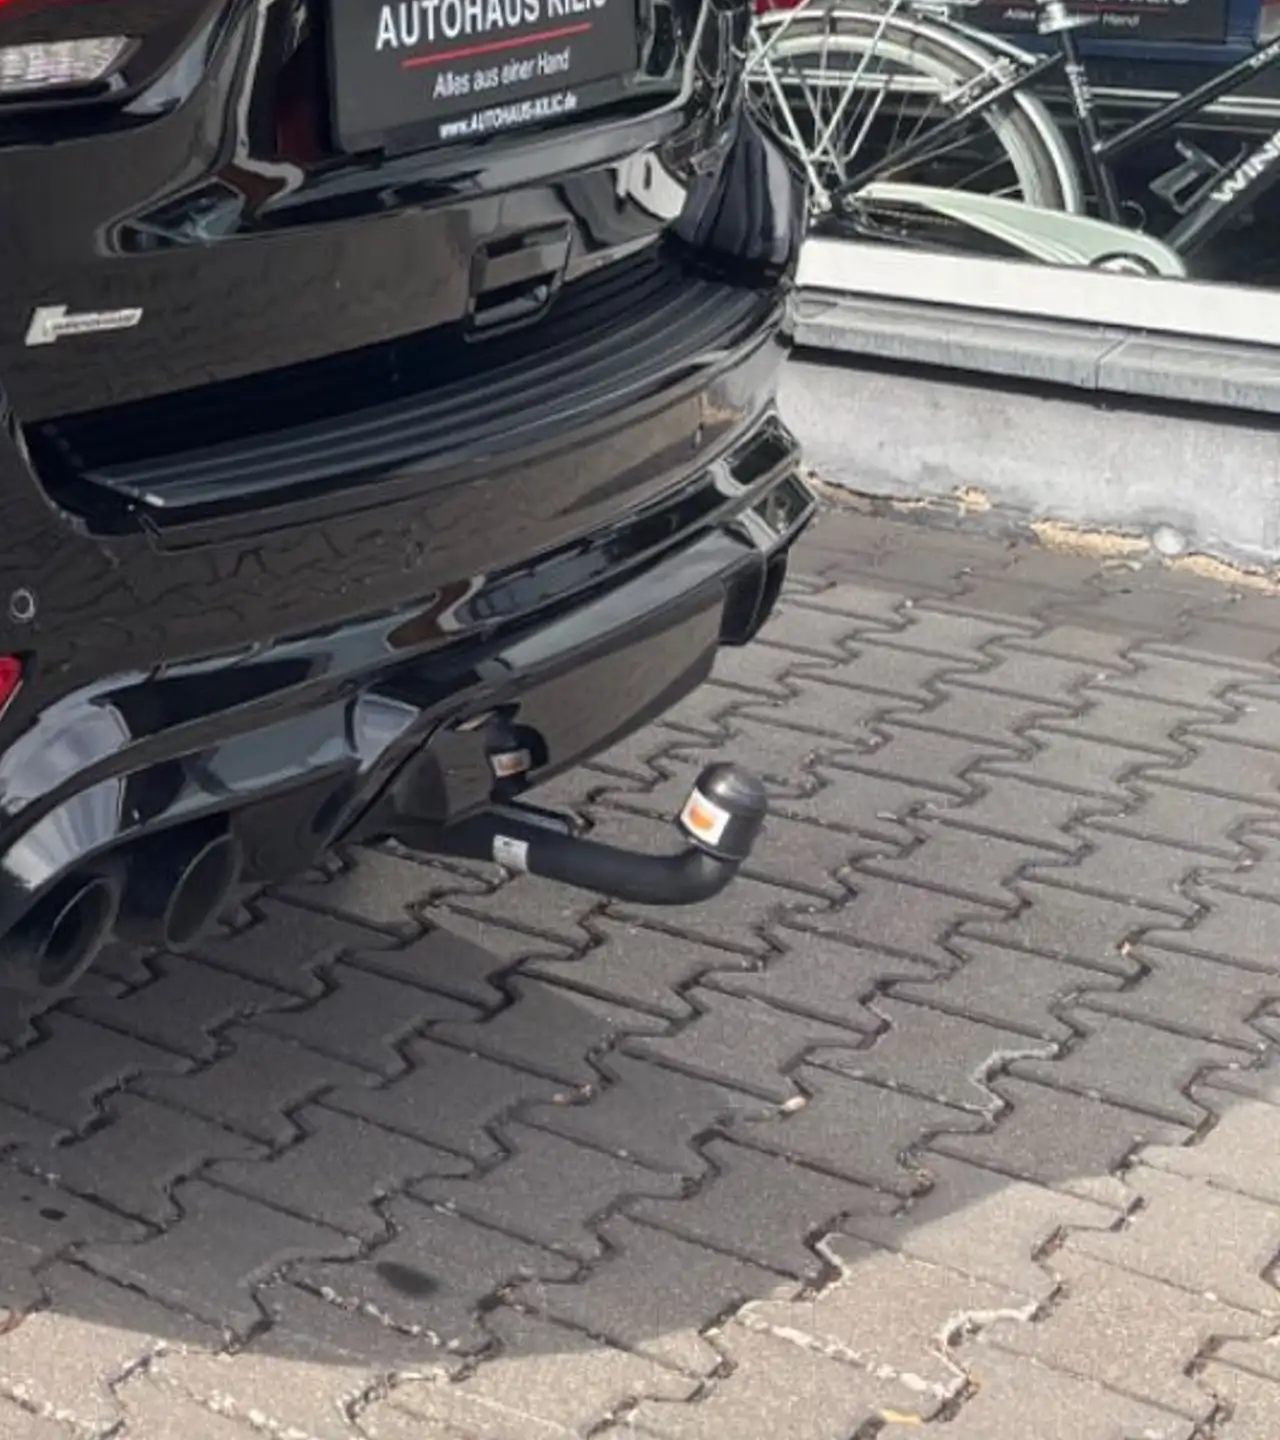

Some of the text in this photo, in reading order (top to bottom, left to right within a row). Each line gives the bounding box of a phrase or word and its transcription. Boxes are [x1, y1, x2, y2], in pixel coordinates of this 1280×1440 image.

[432, 44, 571, 101] Alles aus einer Hand
